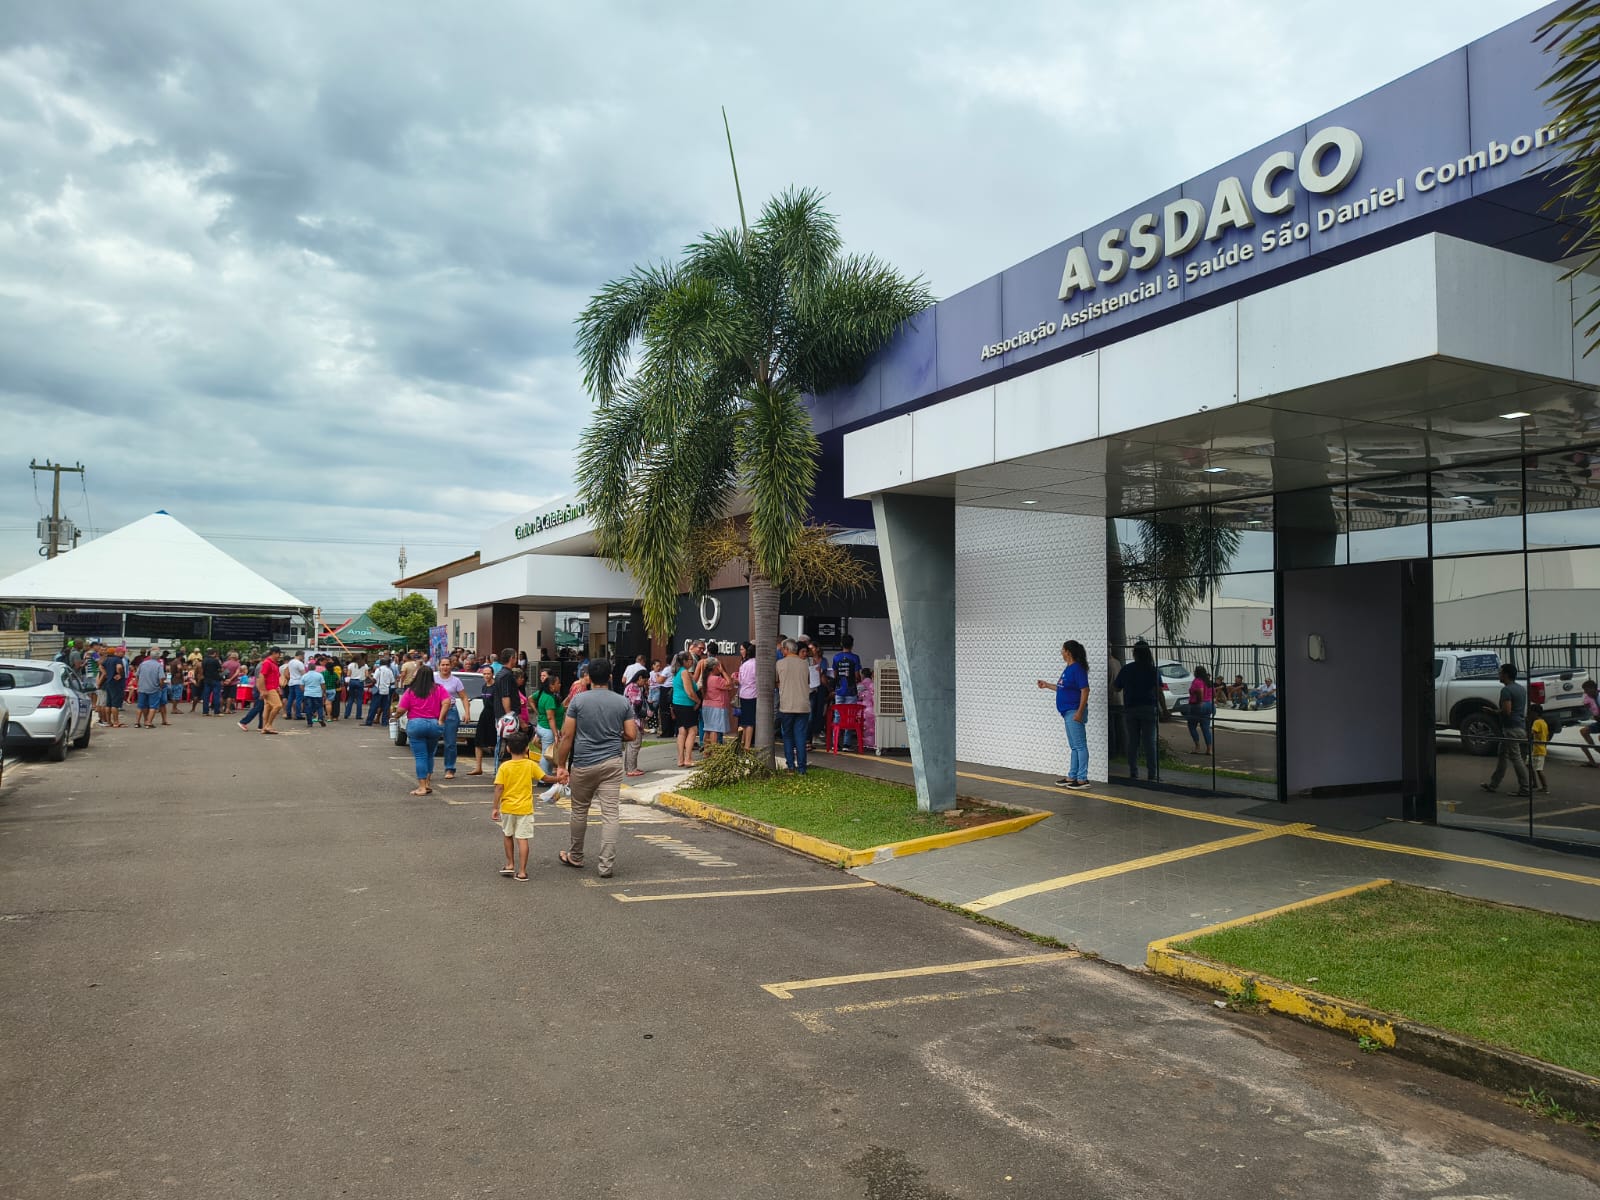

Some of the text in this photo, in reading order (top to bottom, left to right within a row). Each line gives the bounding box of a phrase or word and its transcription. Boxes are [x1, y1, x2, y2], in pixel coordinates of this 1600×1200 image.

[980, 320, 1057, 361] Associação
[1060, 275, 1163, 331] Assistencial
[1166, 269, 1180, 292] à
[1185, 243, 1255, 284] Saúde
[1261, 222, 1311, 253] São
[1317, 177, 1406, 232] Daniel
[1058, 126, 1363, 302] ASSDACO
